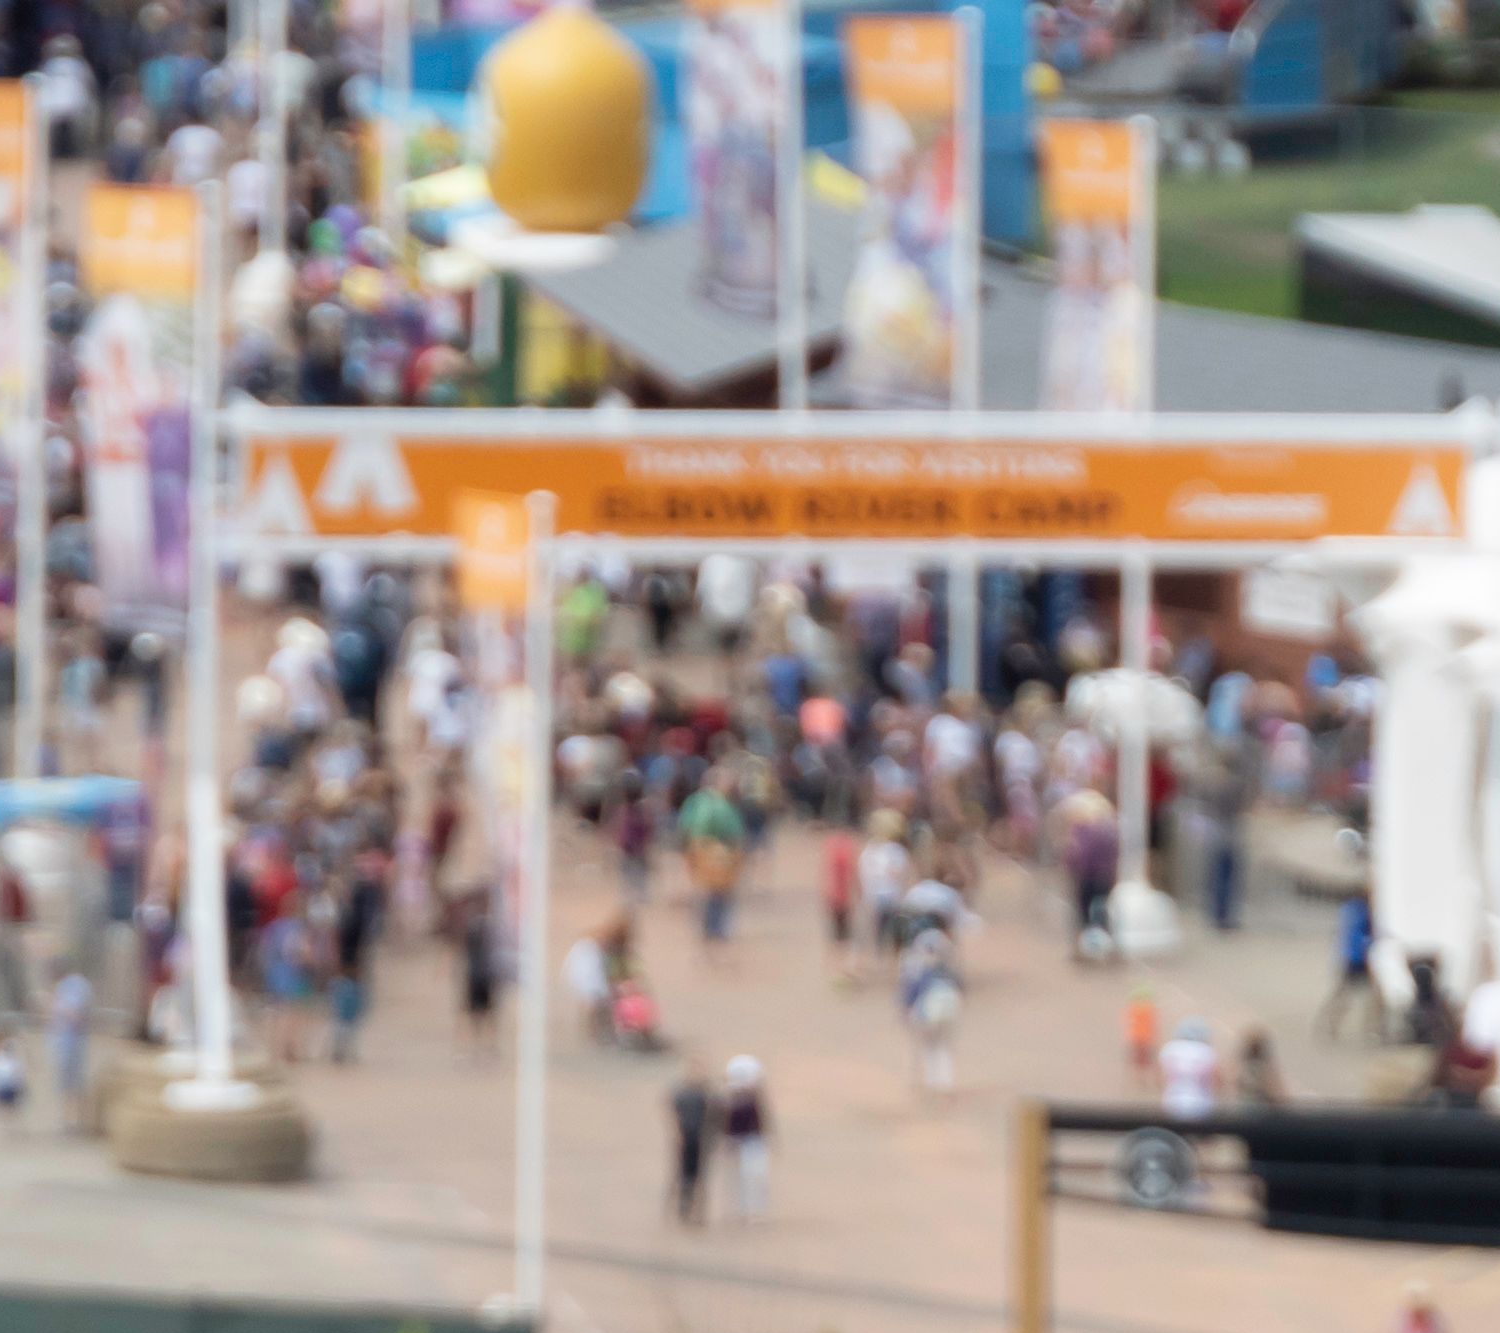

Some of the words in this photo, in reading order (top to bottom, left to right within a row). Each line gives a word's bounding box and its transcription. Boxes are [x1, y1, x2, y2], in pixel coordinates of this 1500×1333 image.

[596, 487, 777, 525] ELBOW
[796, 487, 957, 525] RIVER
[976, 487, 1117, 525] CAMP
